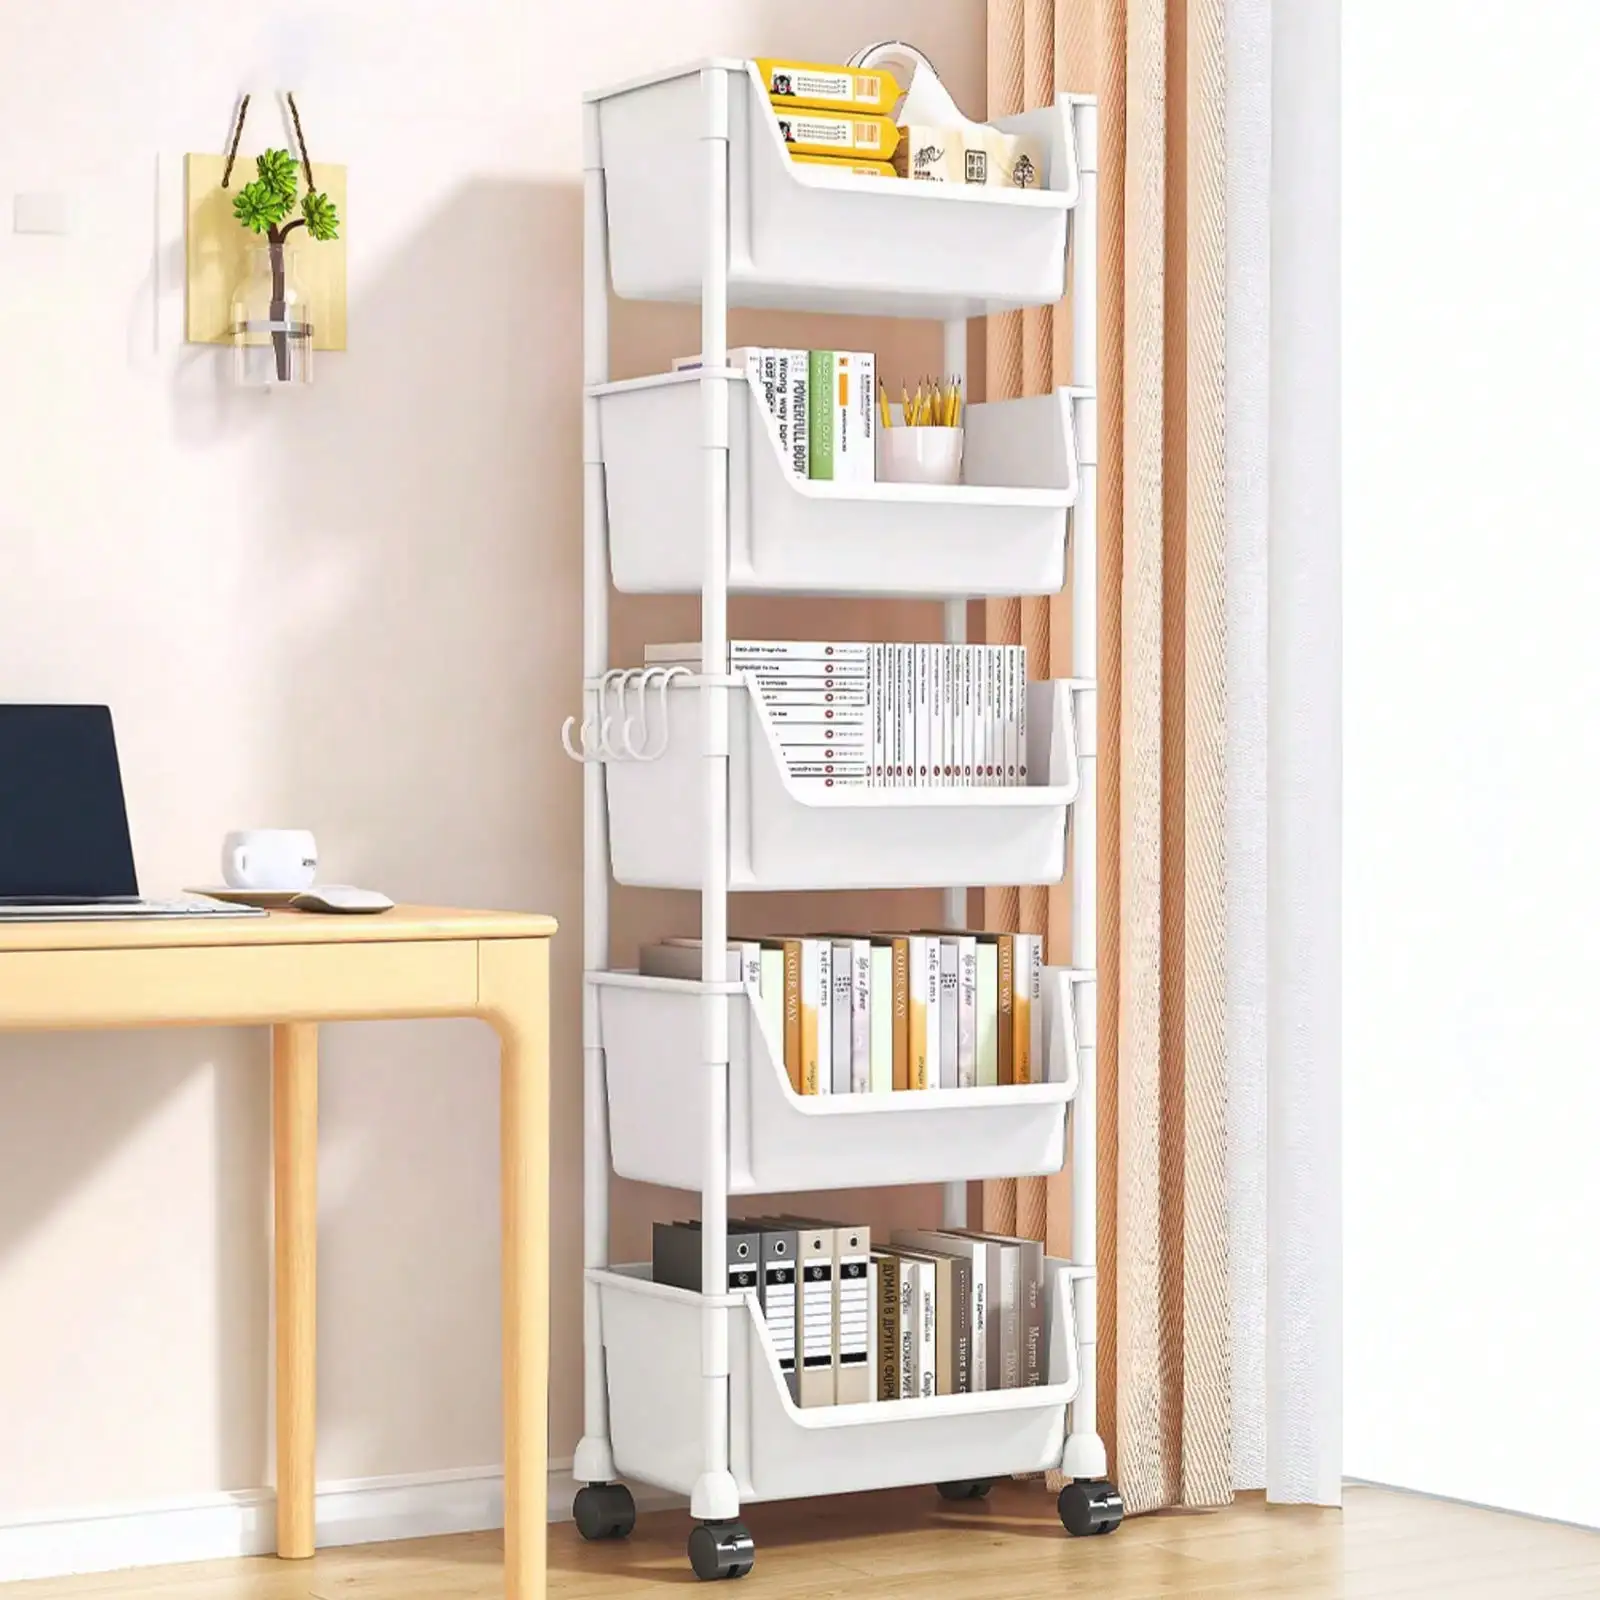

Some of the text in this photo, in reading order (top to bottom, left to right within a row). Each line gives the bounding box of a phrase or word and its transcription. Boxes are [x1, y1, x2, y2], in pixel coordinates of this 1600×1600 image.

[777, 358, 788, 394] Wrong
[778, 398, 787, 420] way
[793, 380, 806, 442] POWERFULL
[793, 445, 806, 474] BODY
[820, 951, 829, 973] safe
[896, 948, 904, 987] YOUR
[930, 948, 938, 971] safe
[788, 951, 796, 1023] YOUR WAY
[1002, 945, 1010, 1015] YOUR WAY
[882, 1264, 897, 1304] ДУМАЙ
[882, 1318, 894, 1361] ДРУГИХ
